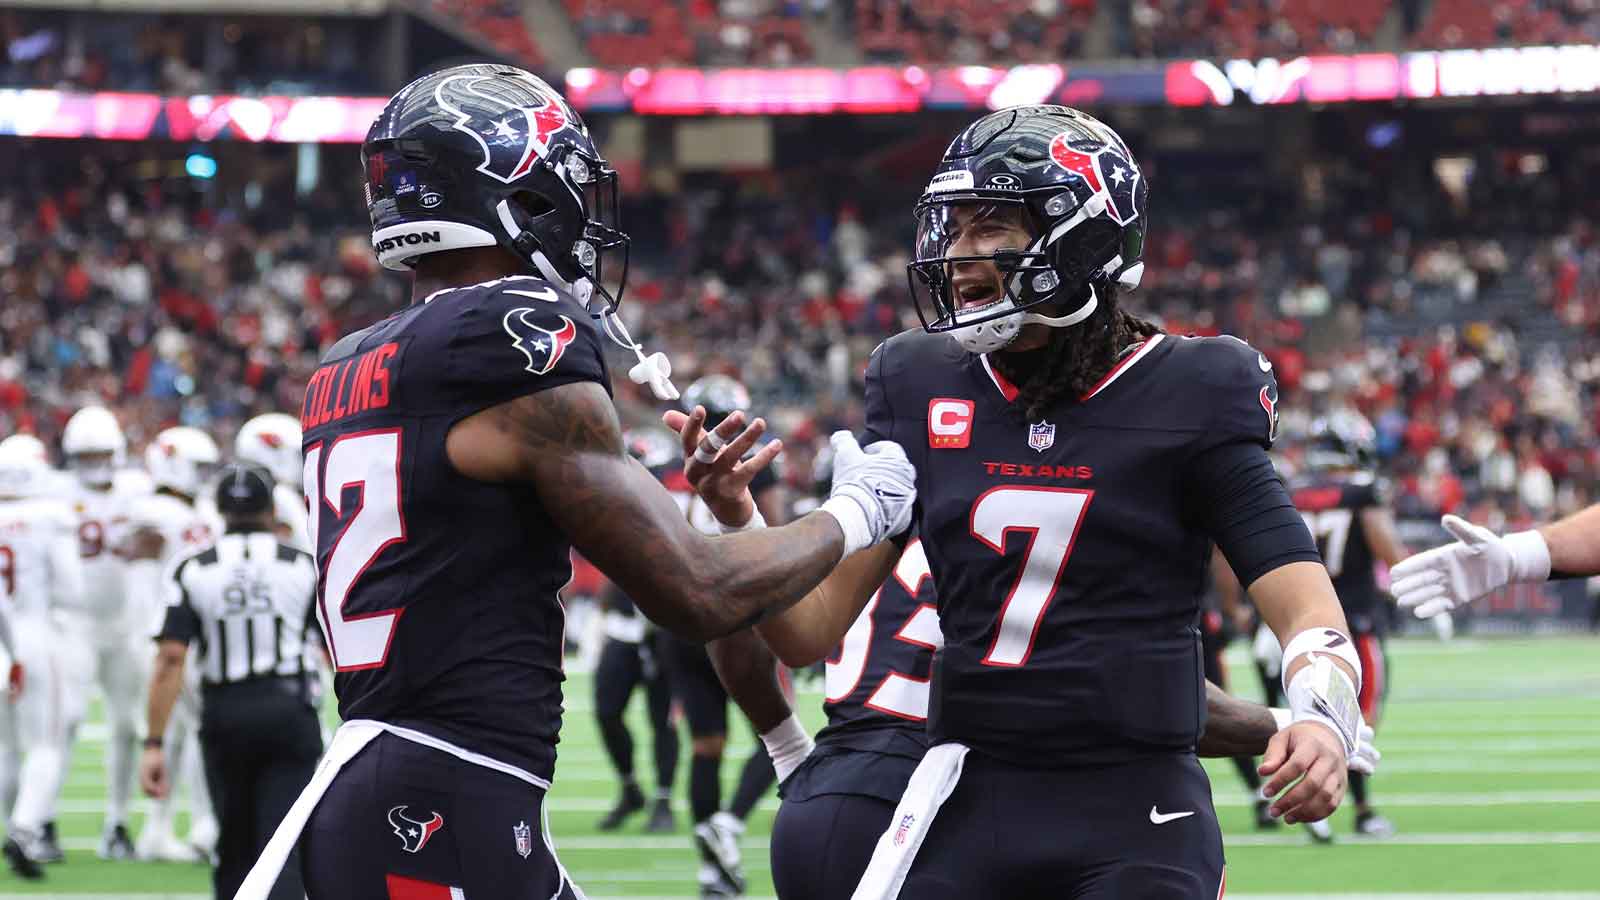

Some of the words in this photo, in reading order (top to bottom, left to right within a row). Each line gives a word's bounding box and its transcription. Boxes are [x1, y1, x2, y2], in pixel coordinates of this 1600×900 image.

[931, 402, 969, 435] C
[984, 462, 1093, 479] TEXANS
[969, 485, 1095, 667] 7
[223, 584, 273, 615] 95
[1324, 630, 1347, 649] 7
